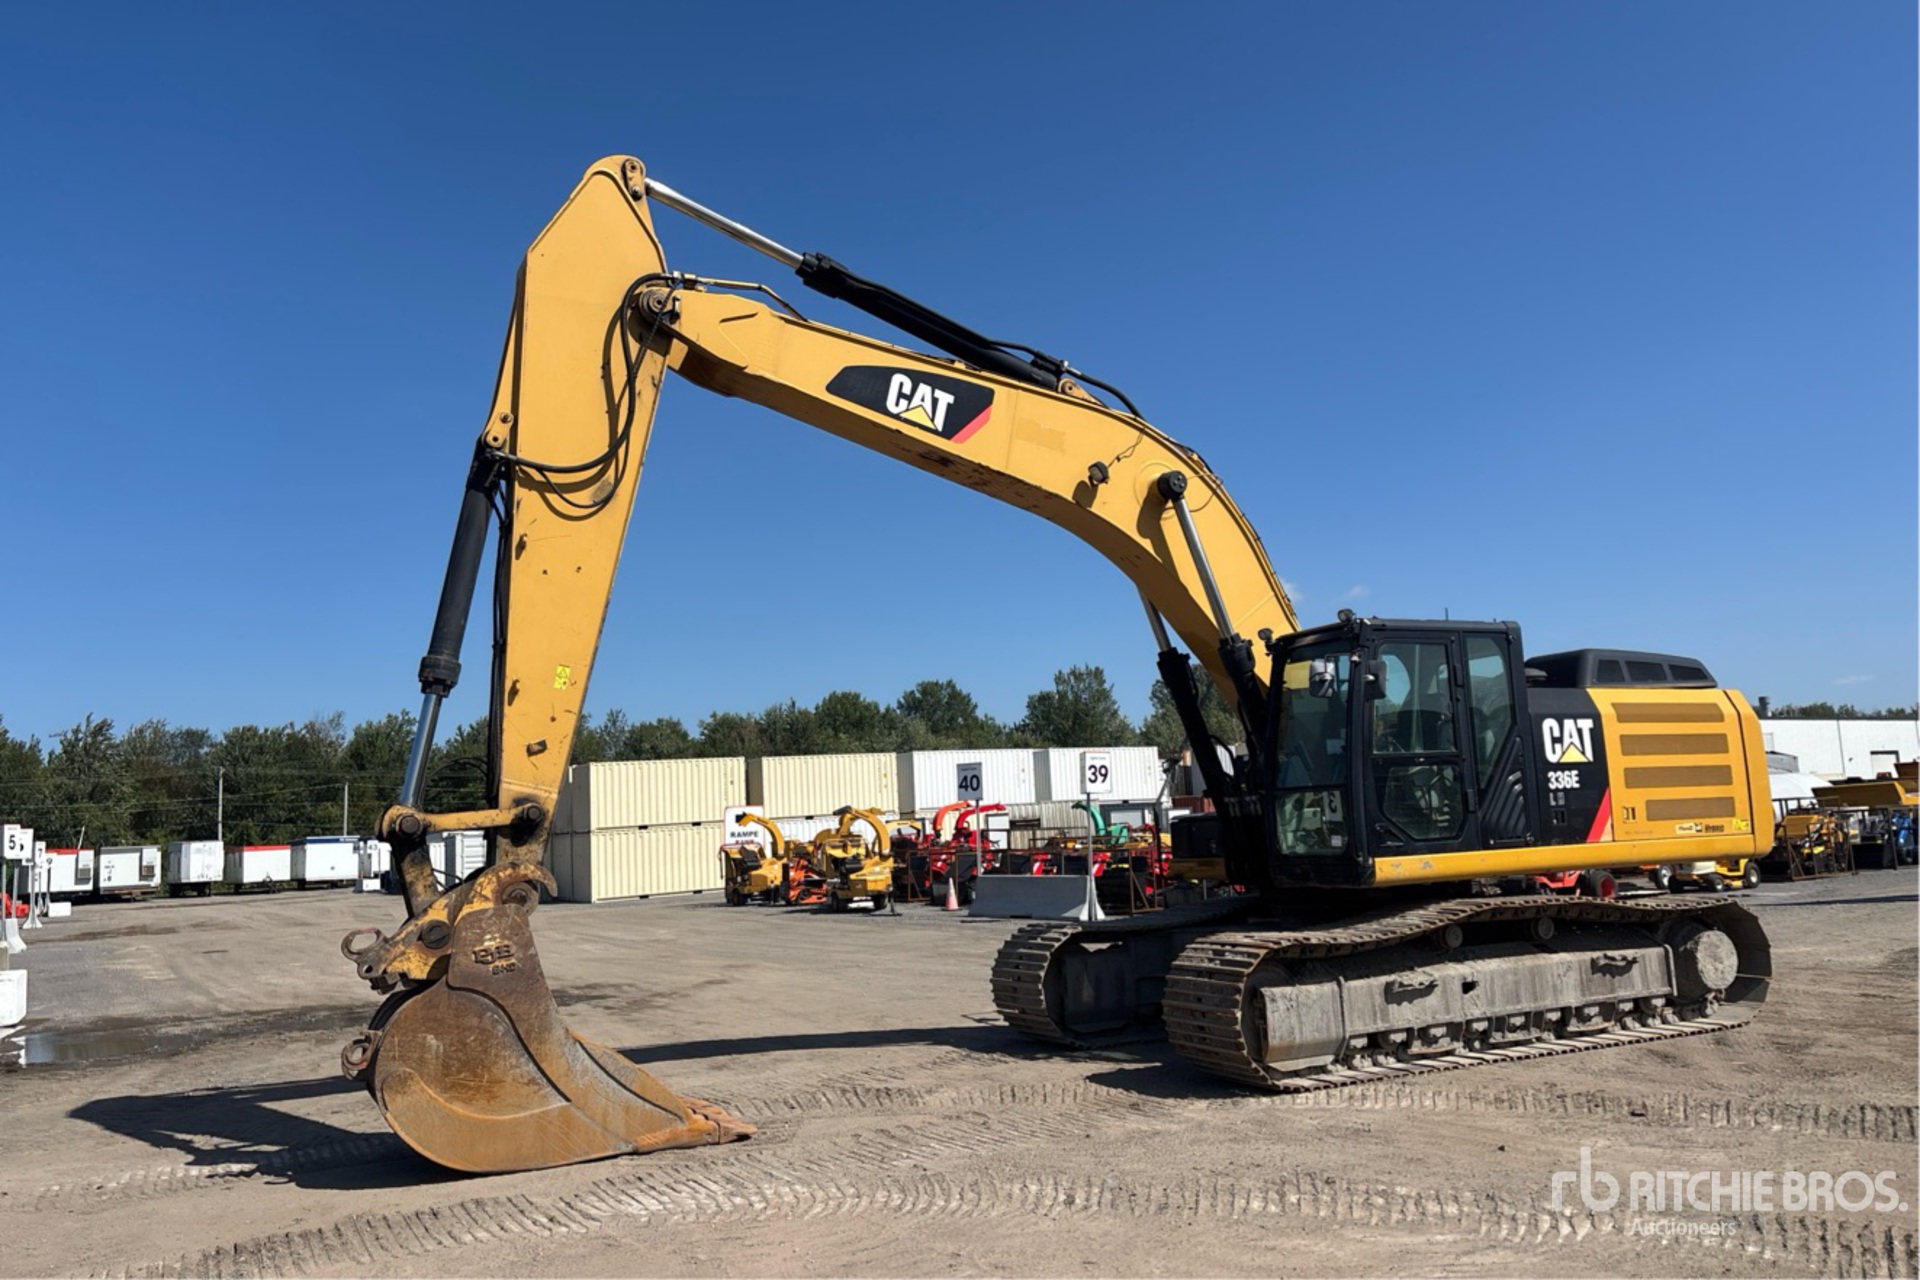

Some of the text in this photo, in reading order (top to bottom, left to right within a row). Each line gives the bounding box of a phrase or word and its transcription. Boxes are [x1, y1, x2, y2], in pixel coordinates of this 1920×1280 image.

[886, 373, 955, 432] CAT
[1542, 718, 1594, 764] CAT
[959, 774, 980, 792] 40
[1088, 765, 1109, 784] 39
[1547, 770, 1580, 790] 336E
[9, 834, 16, 850] 5
[730, 830, 759, 838] RAMPE
